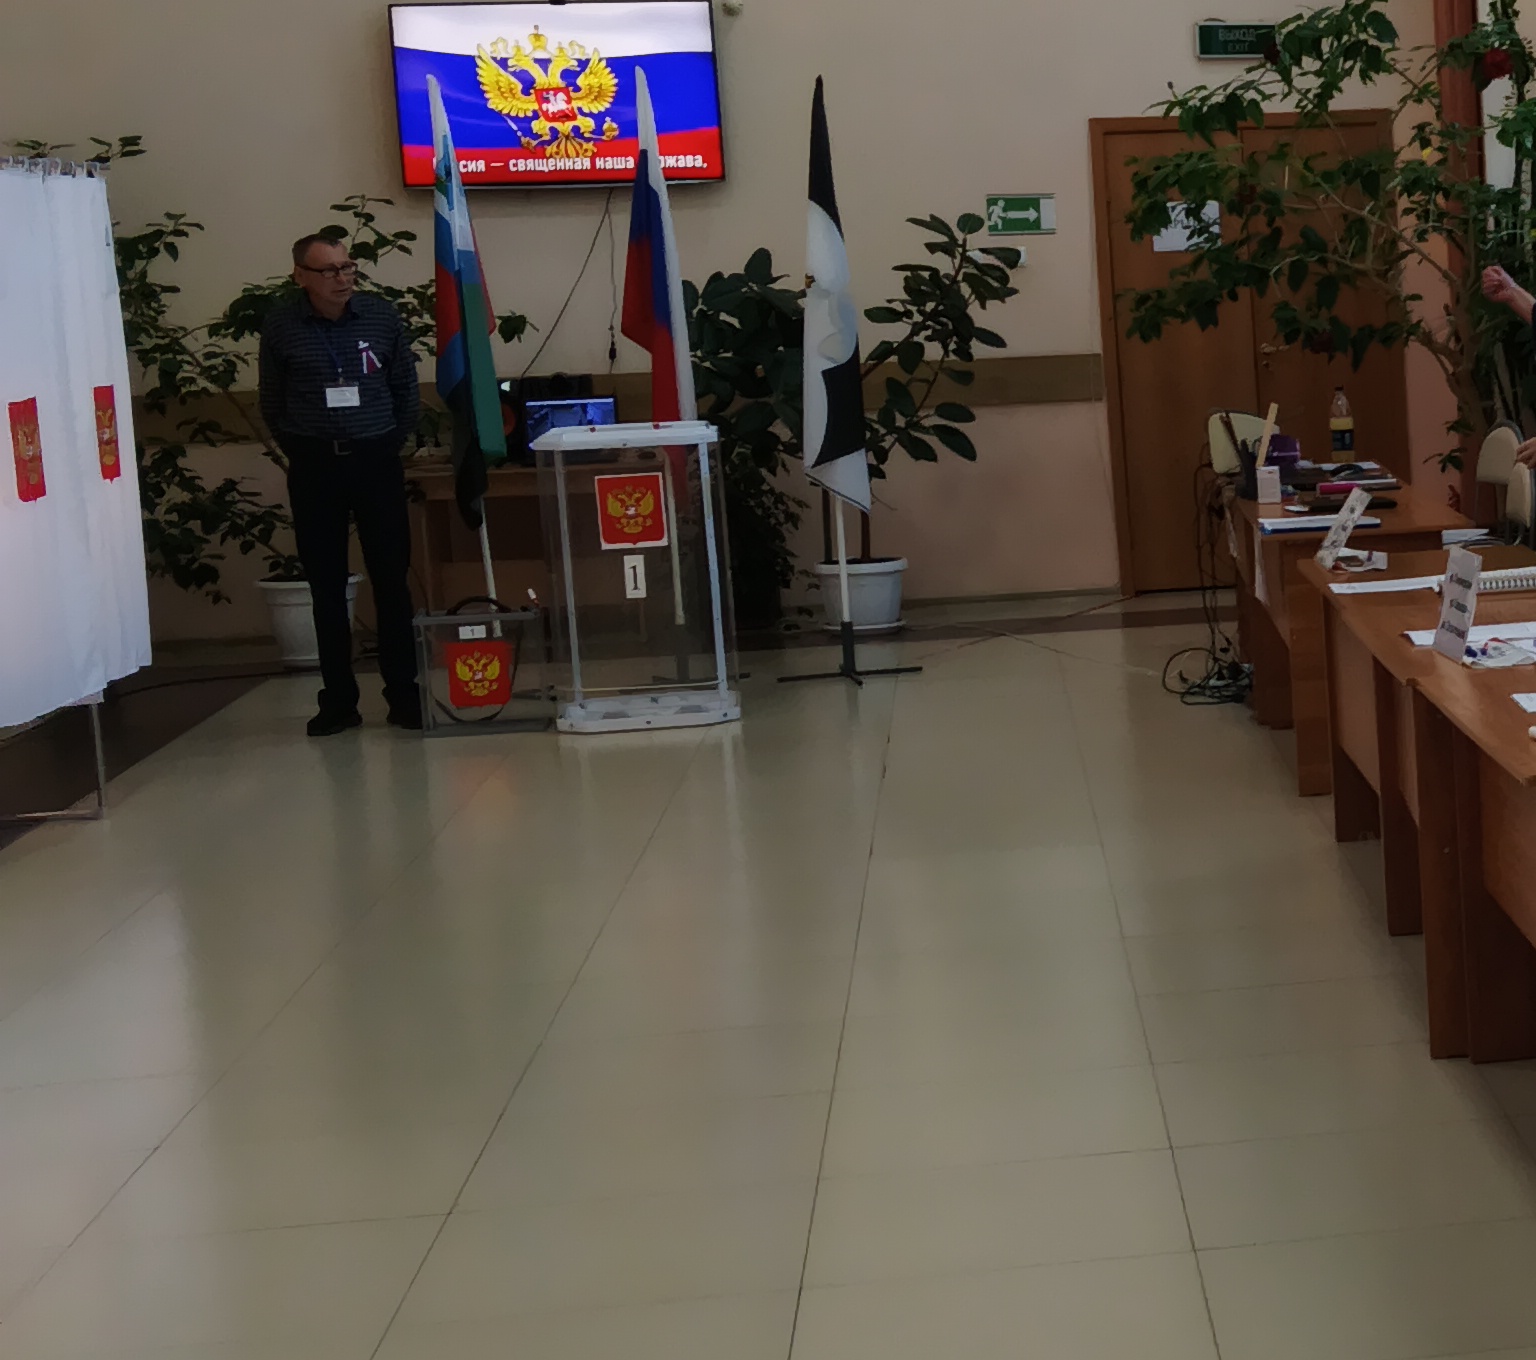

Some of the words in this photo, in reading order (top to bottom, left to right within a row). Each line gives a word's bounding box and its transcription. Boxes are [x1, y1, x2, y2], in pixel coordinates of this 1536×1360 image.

[1218, 28, 1256, 41] ВЫХОД
[1227, 42, 1249, 52] EXIT
[433, 157, 486, 173] сия
[508, 156, 591, 172] священная
[595, 155, 635, 170] наша
[658, 154, 708, 169] жава,
[628, 565, 641, 591] 1
